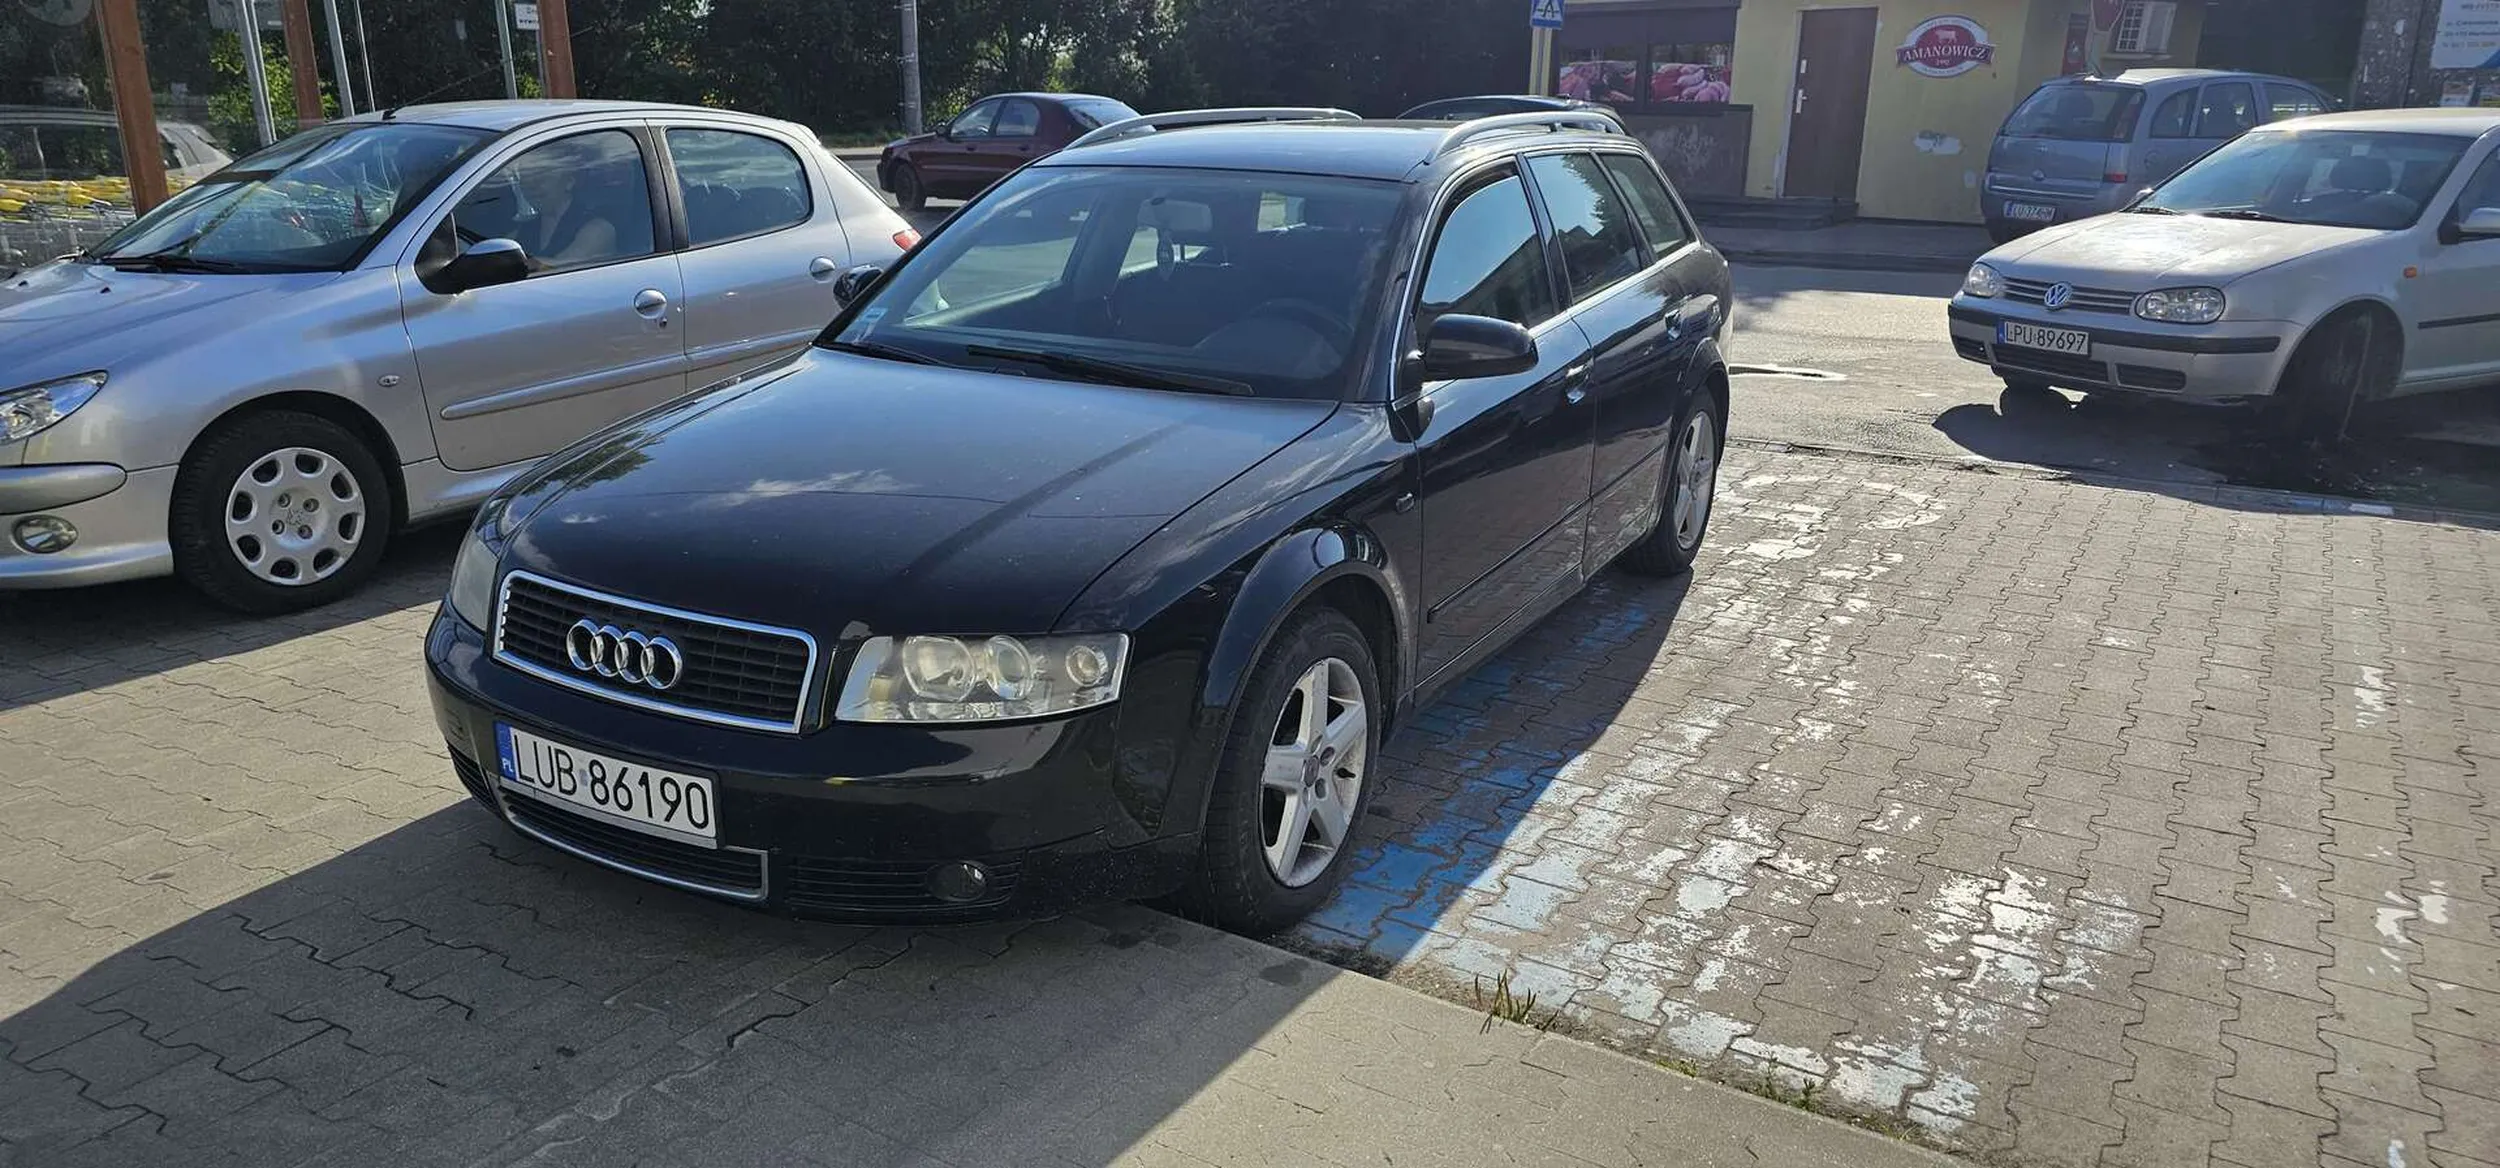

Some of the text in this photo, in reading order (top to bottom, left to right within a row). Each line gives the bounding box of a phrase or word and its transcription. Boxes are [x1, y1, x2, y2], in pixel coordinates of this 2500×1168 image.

[1903, 44, 1987, 62] AMANOWICZ
[2006, 322, 2086, 352] LPU 89697
[502, 757, 514, 773] PL
[514, 734, 709, 830] LUB 86190
